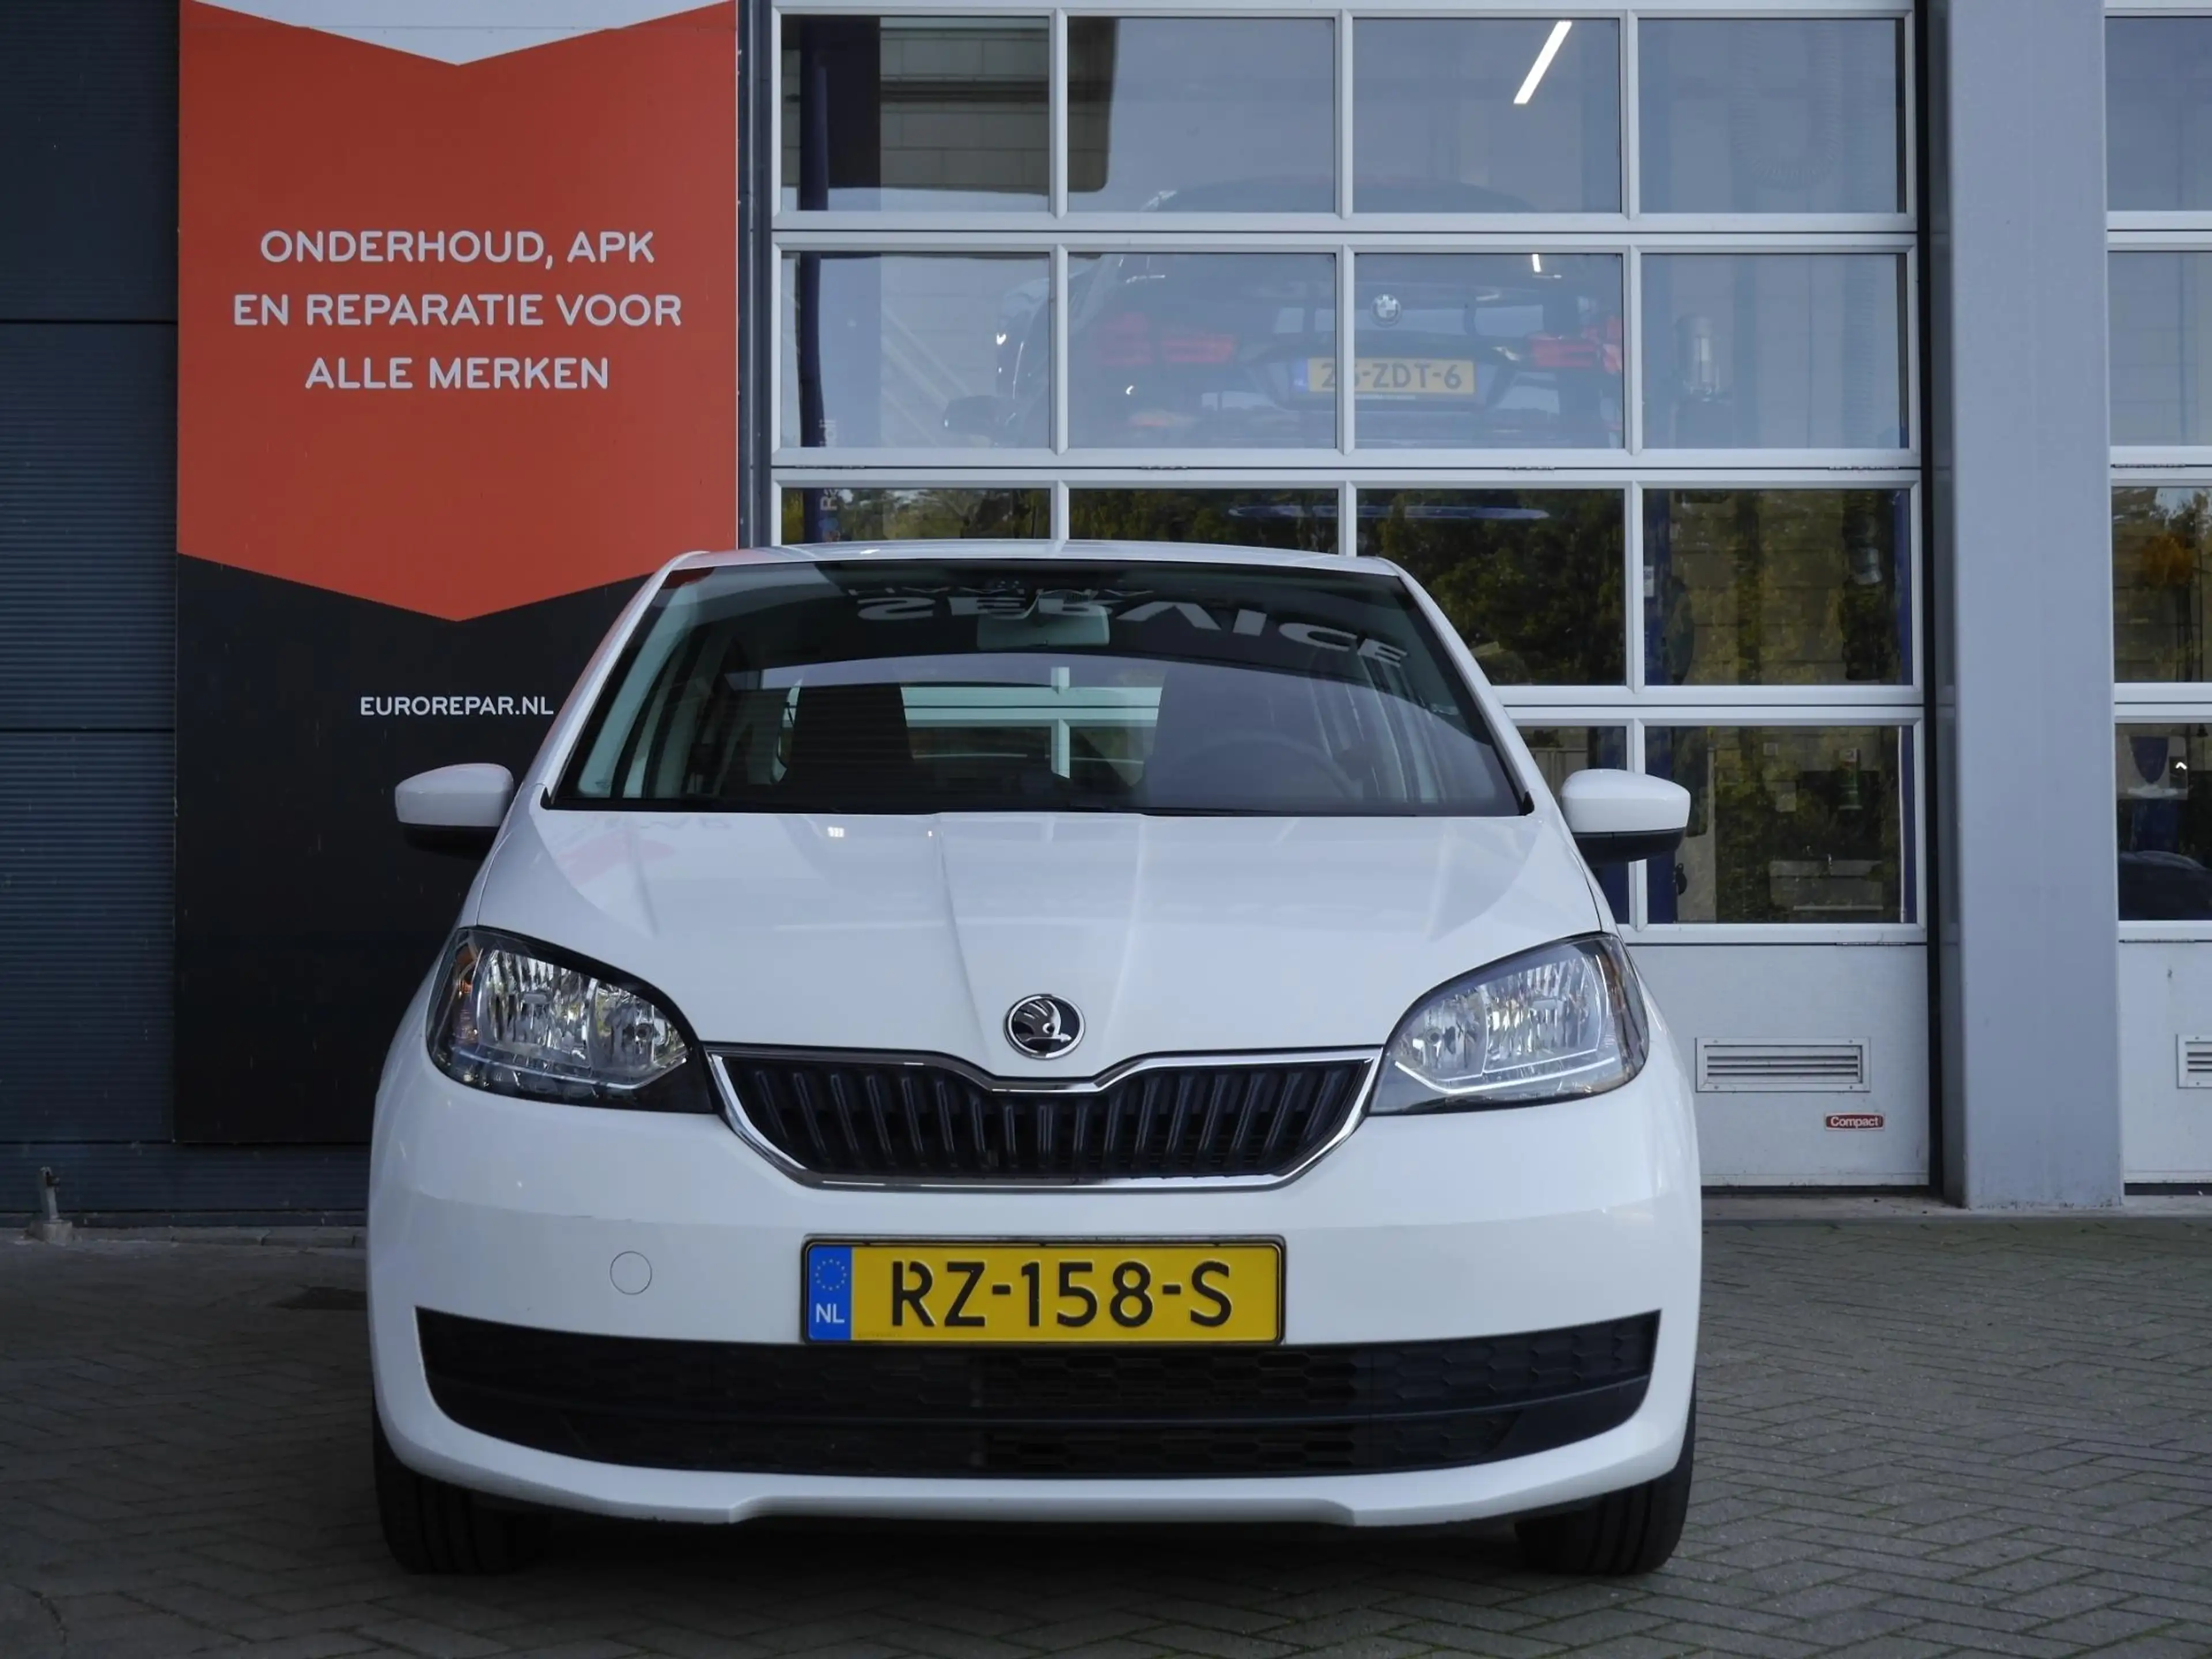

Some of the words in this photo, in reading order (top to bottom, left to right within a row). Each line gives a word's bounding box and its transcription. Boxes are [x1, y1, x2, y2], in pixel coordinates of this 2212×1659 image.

[260, 230, 554, 270] ONDERHOUD,
[566, 230, 655, 263] APK
[233, 293, 289, 327] EN
[306, 293, 544, 327] REPARATIE
[555, 293, 682, 327] VOOR
[305, 357, 413, 389] ALLE
[429, 357, 609, 389] MERKEN
[359, 695, 554, 716] EUROREPAR.NL
[1830, 1116, 1879, 1130] Compact
[815, 1302, 846, 1323] NL
[891, 1260, 1233, 1328] RZ-158-S
